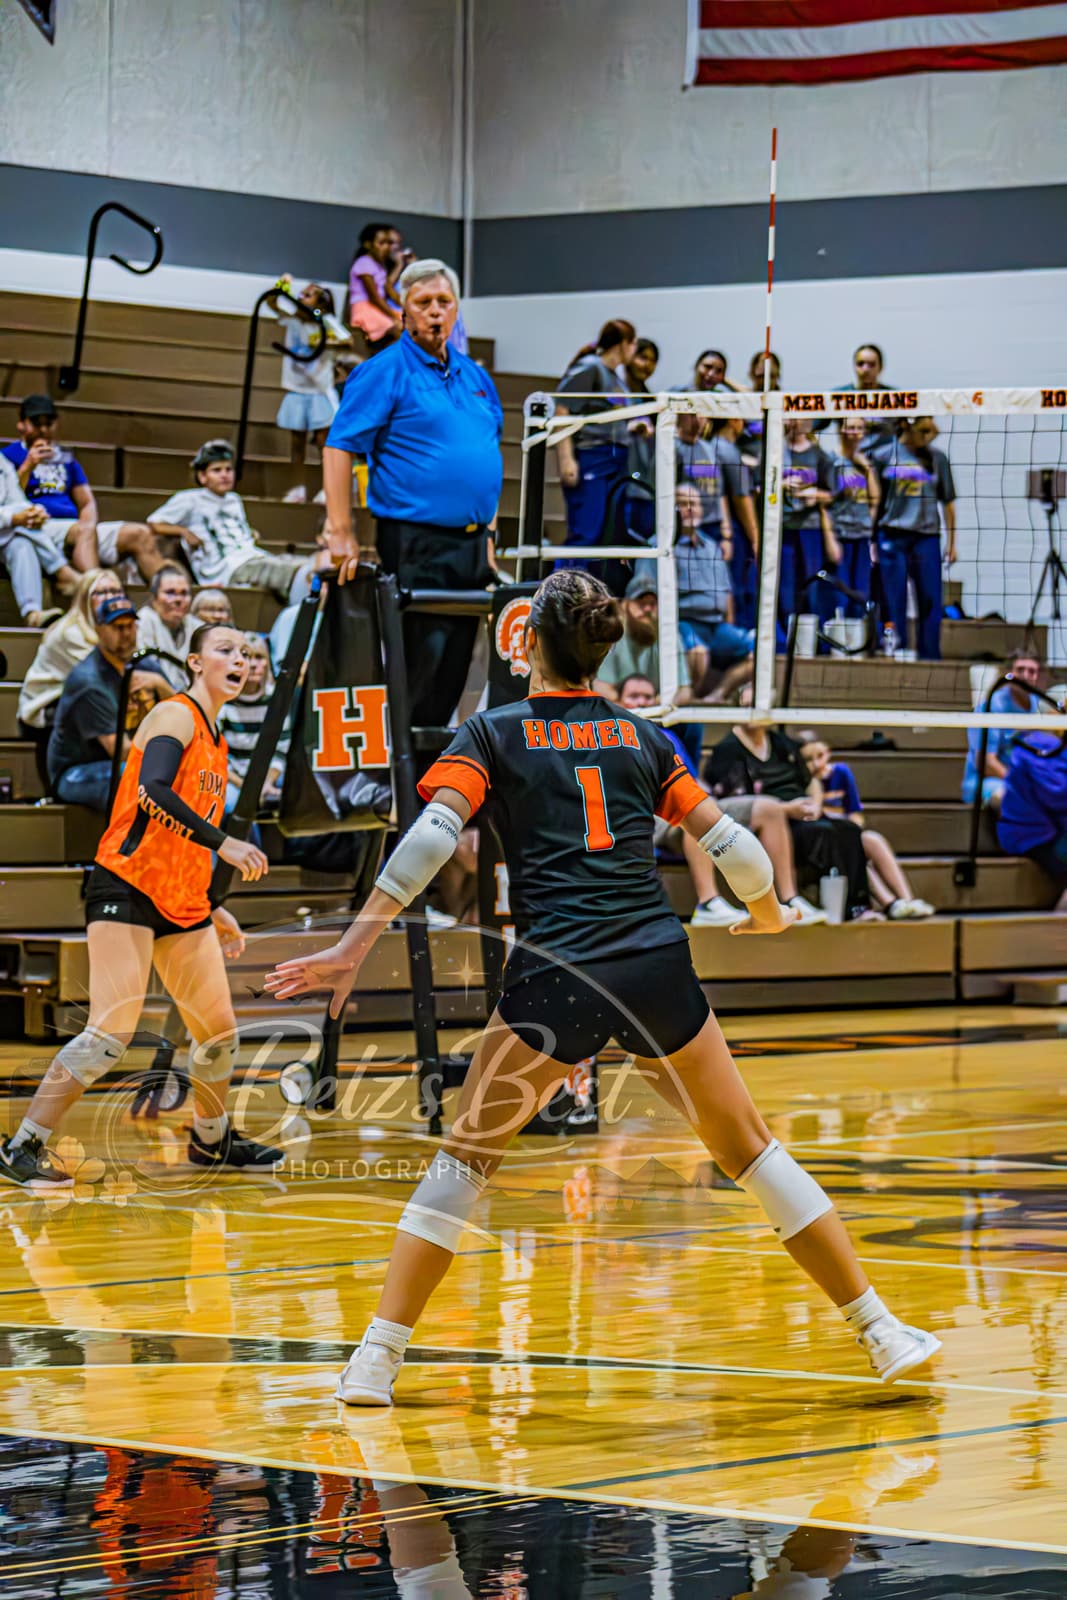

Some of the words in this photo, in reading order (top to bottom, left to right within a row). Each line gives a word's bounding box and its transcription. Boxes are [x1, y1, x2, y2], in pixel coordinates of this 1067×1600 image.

[784, 393, 825, 411] MER
[831, 392, 918, 410] TROJANS
[1040, 389, 1067, 408] HO
[312, 685, 391, 772] H
[522, 718, 641, 750] HOMER
[575, 766, 615, 852] 1
